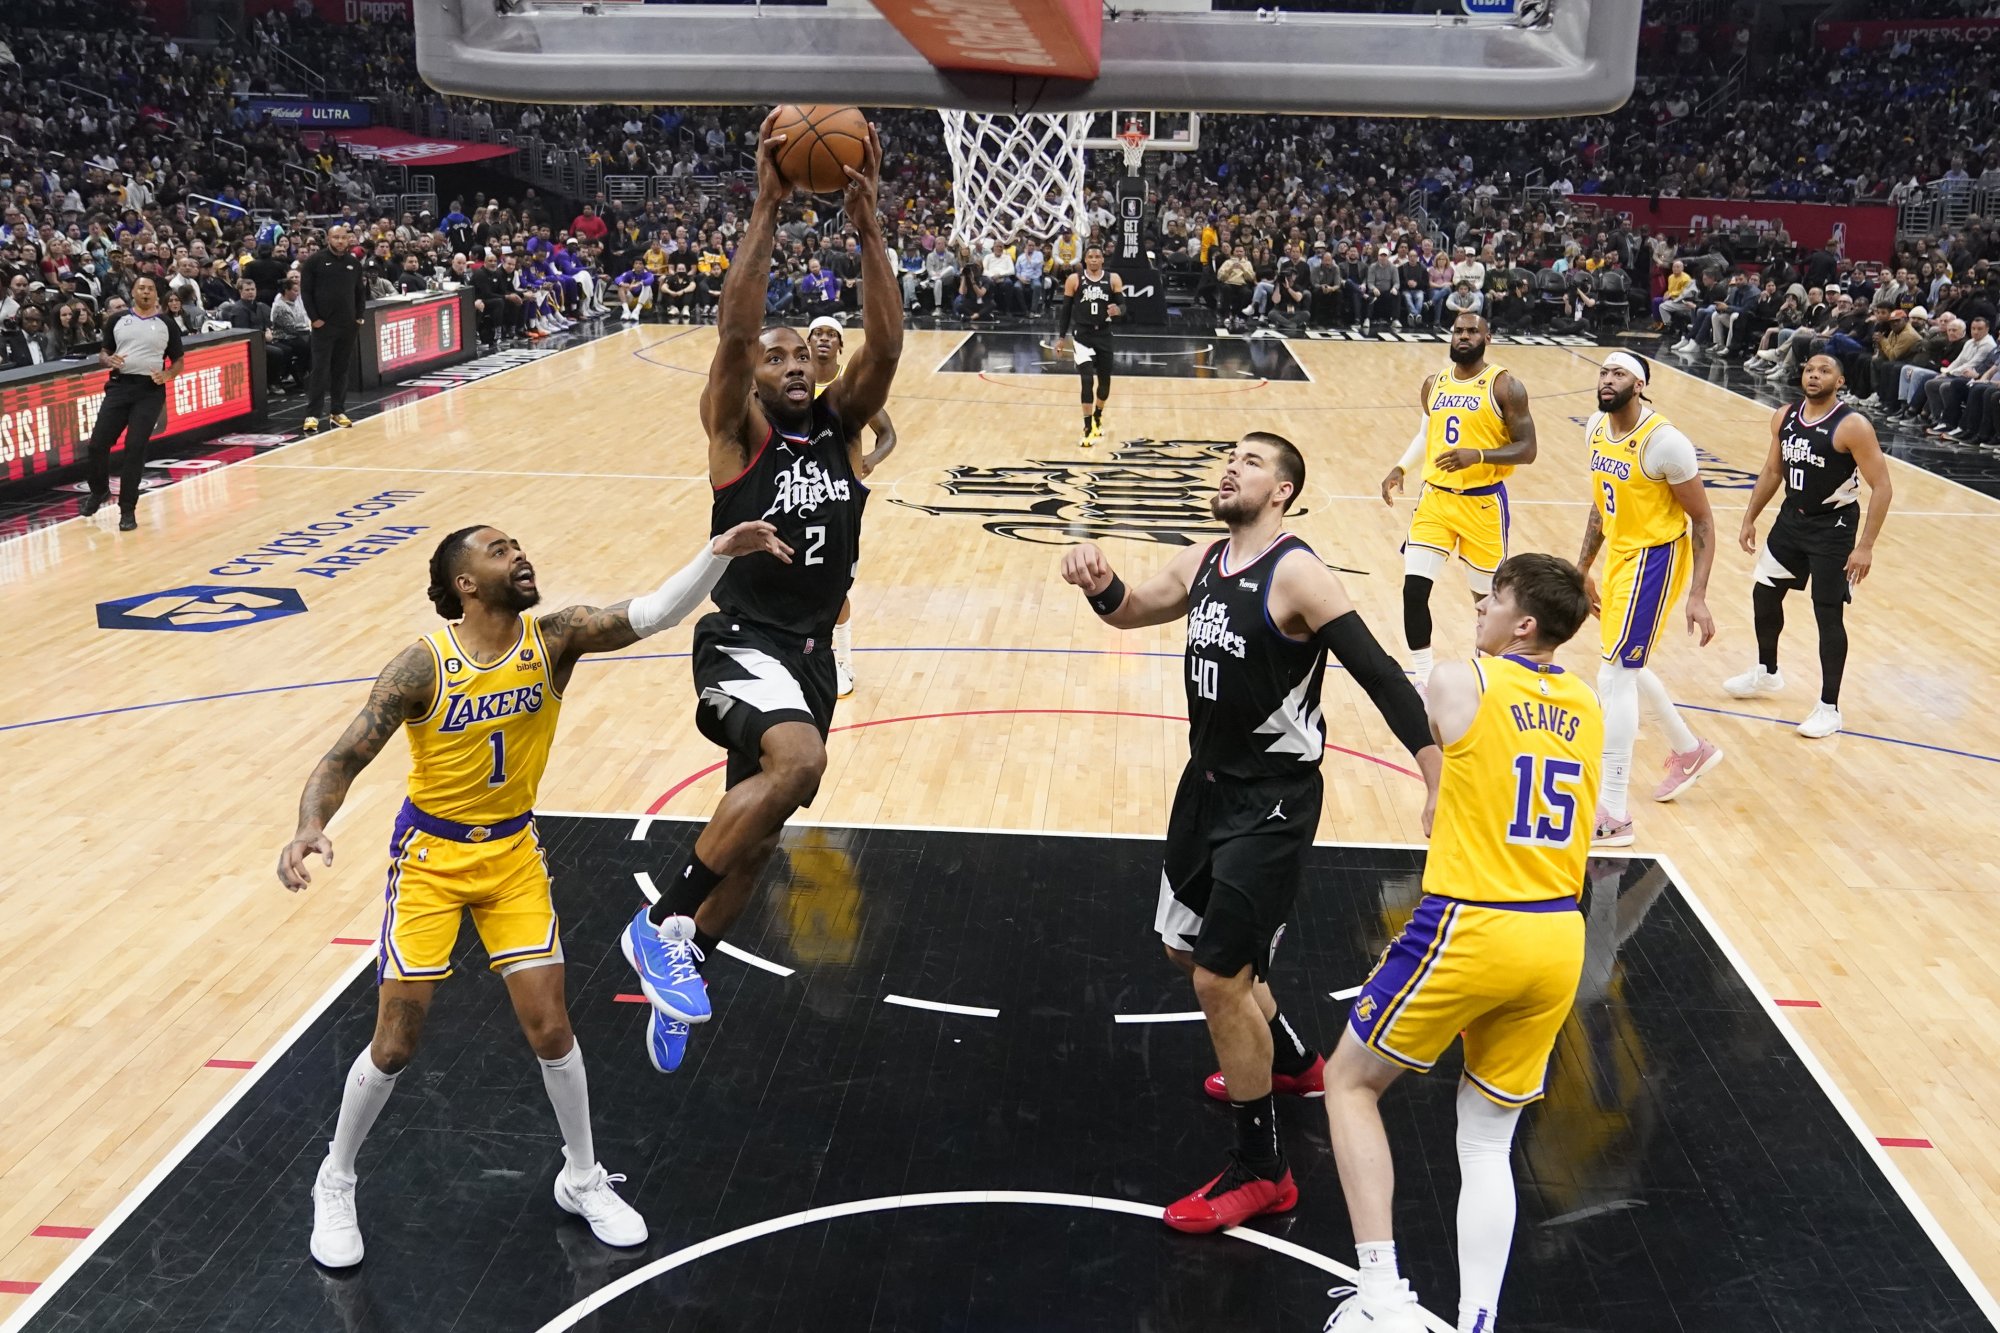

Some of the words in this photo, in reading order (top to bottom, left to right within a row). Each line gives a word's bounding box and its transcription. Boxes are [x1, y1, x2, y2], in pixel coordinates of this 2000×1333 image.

[312, 108, 350, 119] ULTRA
[1123, 220, 1139, 233] GET
[1123, 233, 1139, 246] THE
[1123, 245, 1139, 259] APP
[1091, 302, 1098, 315] 0
[381, 322, 397, 361] GET
[174, 371, 198, 416] GET
[199, 366, 223, 408] THE
[1431, 392, 1481, 411] LAKERS
[1445, 415, 1460, 445] 6
[1591, 449, 1631, 481] LAKERS
[1789, 467, 1805, 491] 10
[1603, 481, 1615, 514] 3
[209, 490, 425, 576] crypto.com
[805, 525, 826, 566] 2
[296, 525, 431, 579] ARENA
[1199, 593, 1228, 624] Los
[447, 659, 460, 673] 6
[516, 661, 542, 671] bibigo
[1191, 655, 1219, 701] 40
[438, 682, 544, 733] LAKERS
[1510, 702, 1580, 742] REAVES
[488, 730, 506, 787] 1
[1506, 753, 1583, 848] 15
